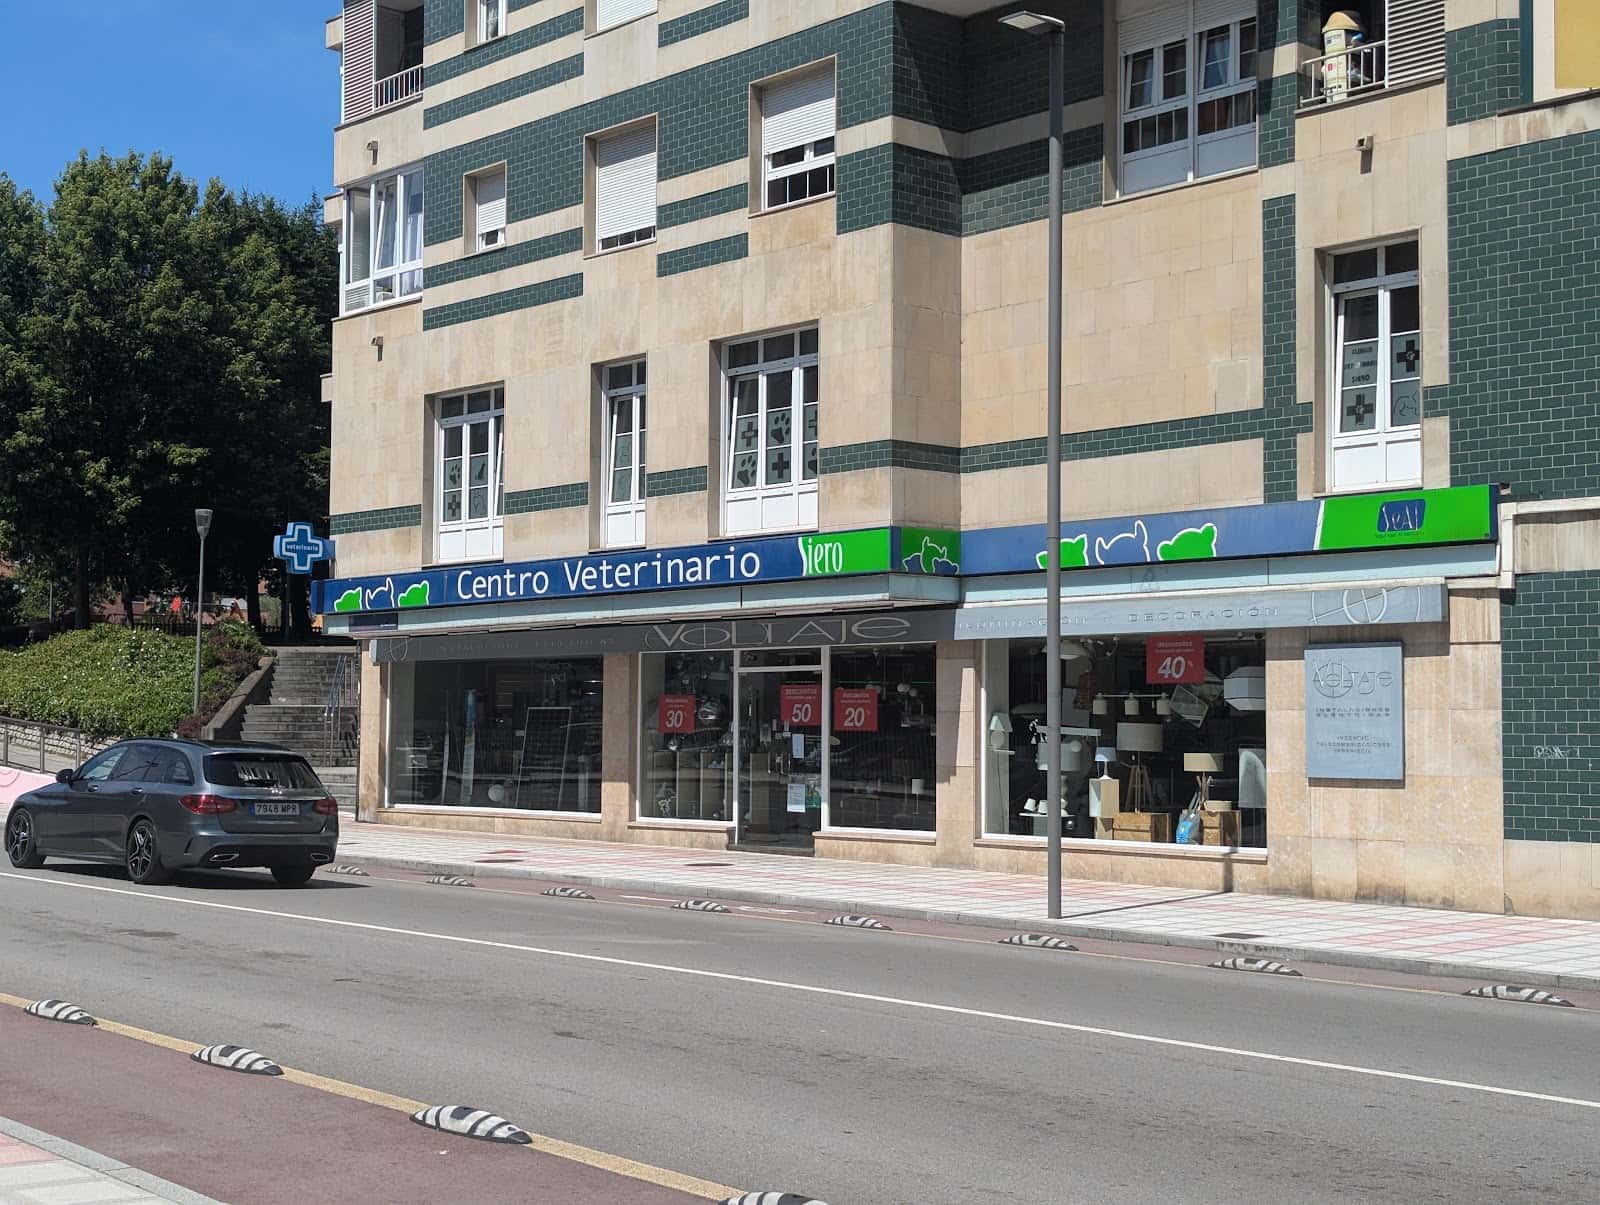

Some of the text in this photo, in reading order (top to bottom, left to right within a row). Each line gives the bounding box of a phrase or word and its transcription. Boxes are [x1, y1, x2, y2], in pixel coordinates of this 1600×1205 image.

[457, 536, 843, 600] Centro Veterinario Siero
